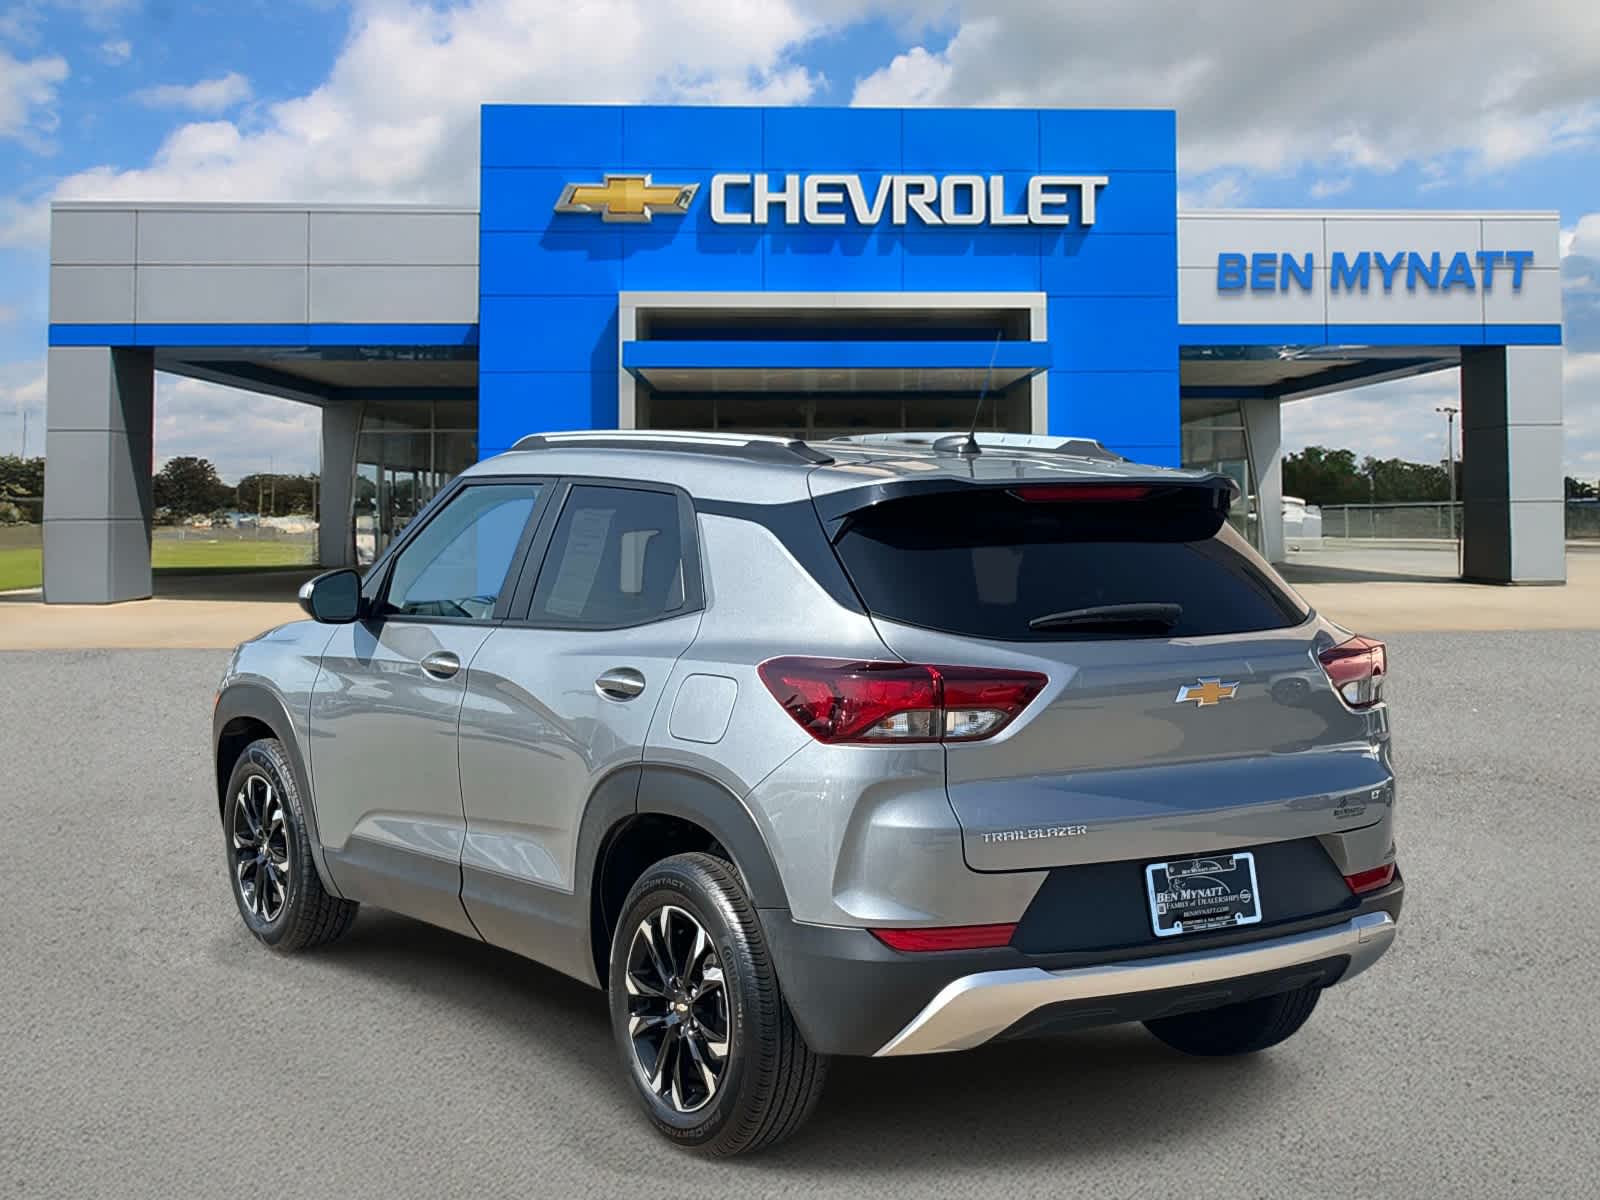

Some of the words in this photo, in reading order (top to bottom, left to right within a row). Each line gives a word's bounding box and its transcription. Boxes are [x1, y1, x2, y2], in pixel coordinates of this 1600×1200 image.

[710, 173, 1109, 226] CHEVROLET
[1217, 251, 1313, 291] BEN
[1330, 249, 1534, 291] MYNATT
[982, 824, 1088, 843] TRAILBLAZER
[1157, 892, 1179, 903] BEN
[1181, 887, 1224, 900] MYNATT
